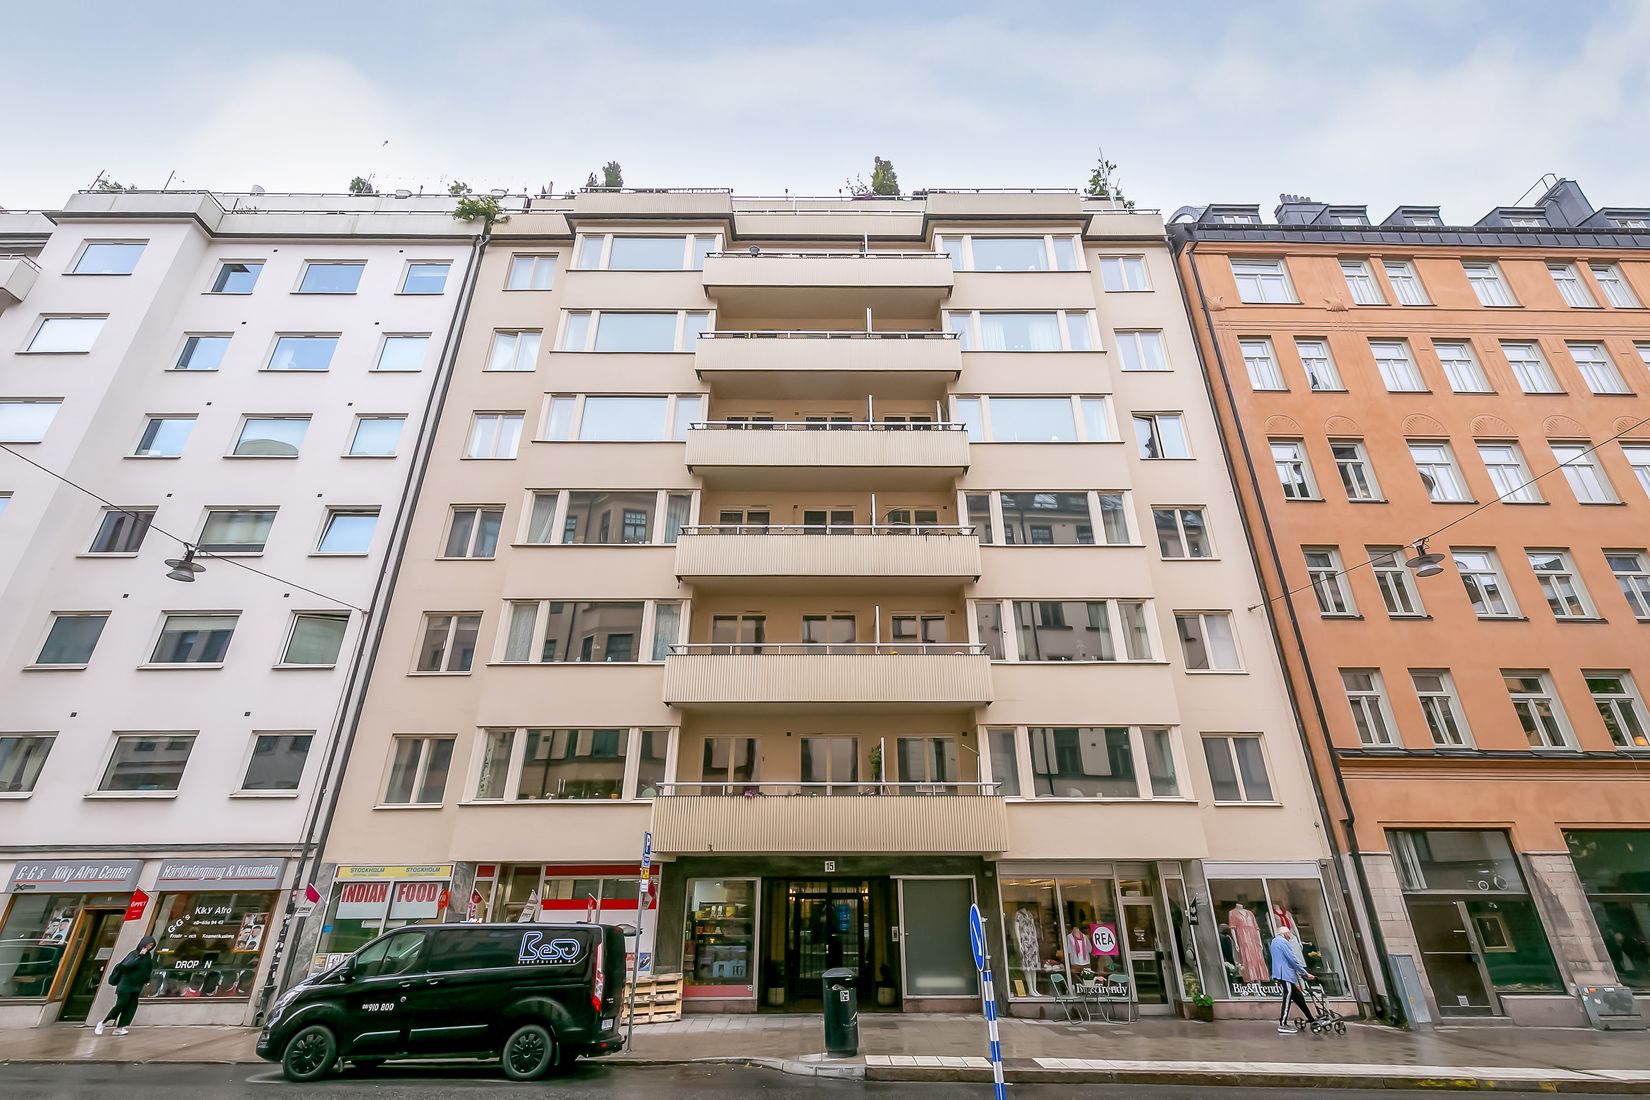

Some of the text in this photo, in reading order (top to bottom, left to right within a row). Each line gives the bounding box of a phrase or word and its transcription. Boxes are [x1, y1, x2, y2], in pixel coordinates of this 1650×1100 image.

[226, 865, 236, 877] &
[235, 864, 279, 877] Kosmetika
[826, 862, 834, 871] 15
[51, 866, 75, 882] Kiky
[74, 866, 99, 880] Afro
[98, 865, 132, 879] Center
[341, 884, 388, 902] INDIAN
[397, 883, 438, 903] FOOD
[214, 906, 232, 914] Afro
[1094, 932, 1115, 945] REA
[175, 960, 199, 969] DROP
[380, 1003, 395, 1011] 800
